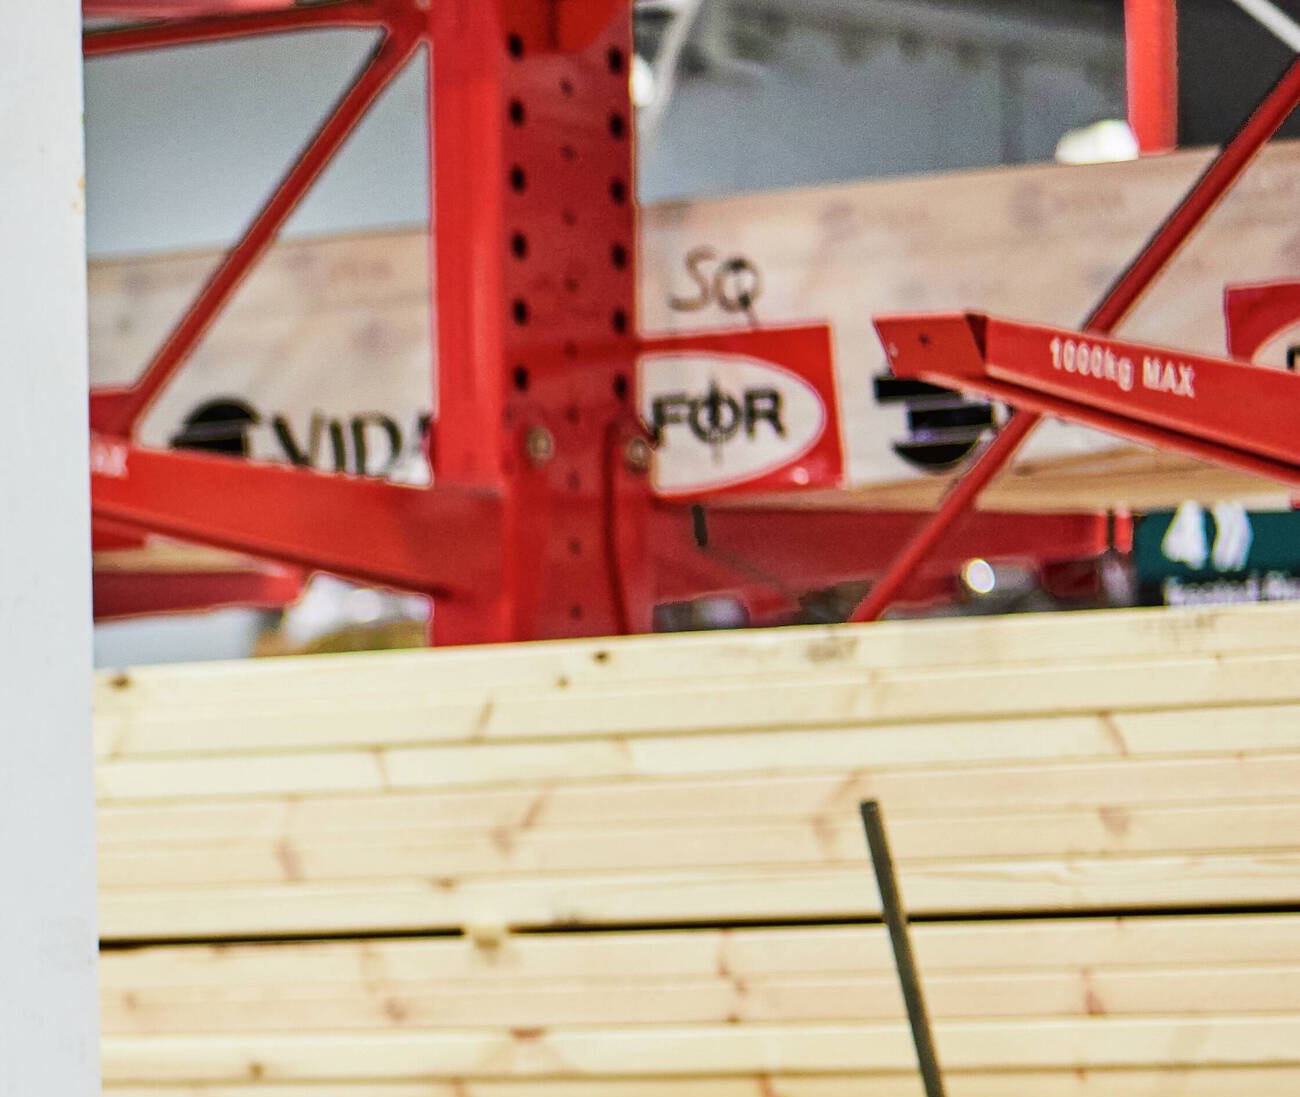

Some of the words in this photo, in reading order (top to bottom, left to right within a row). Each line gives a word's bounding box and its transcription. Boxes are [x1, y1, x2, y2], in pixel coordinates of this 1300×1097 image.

[1050, 337, 1134, 391] 1000kg
[1143, 356, 1196, 398] MAX
[272, 408, 433, 479] VID
